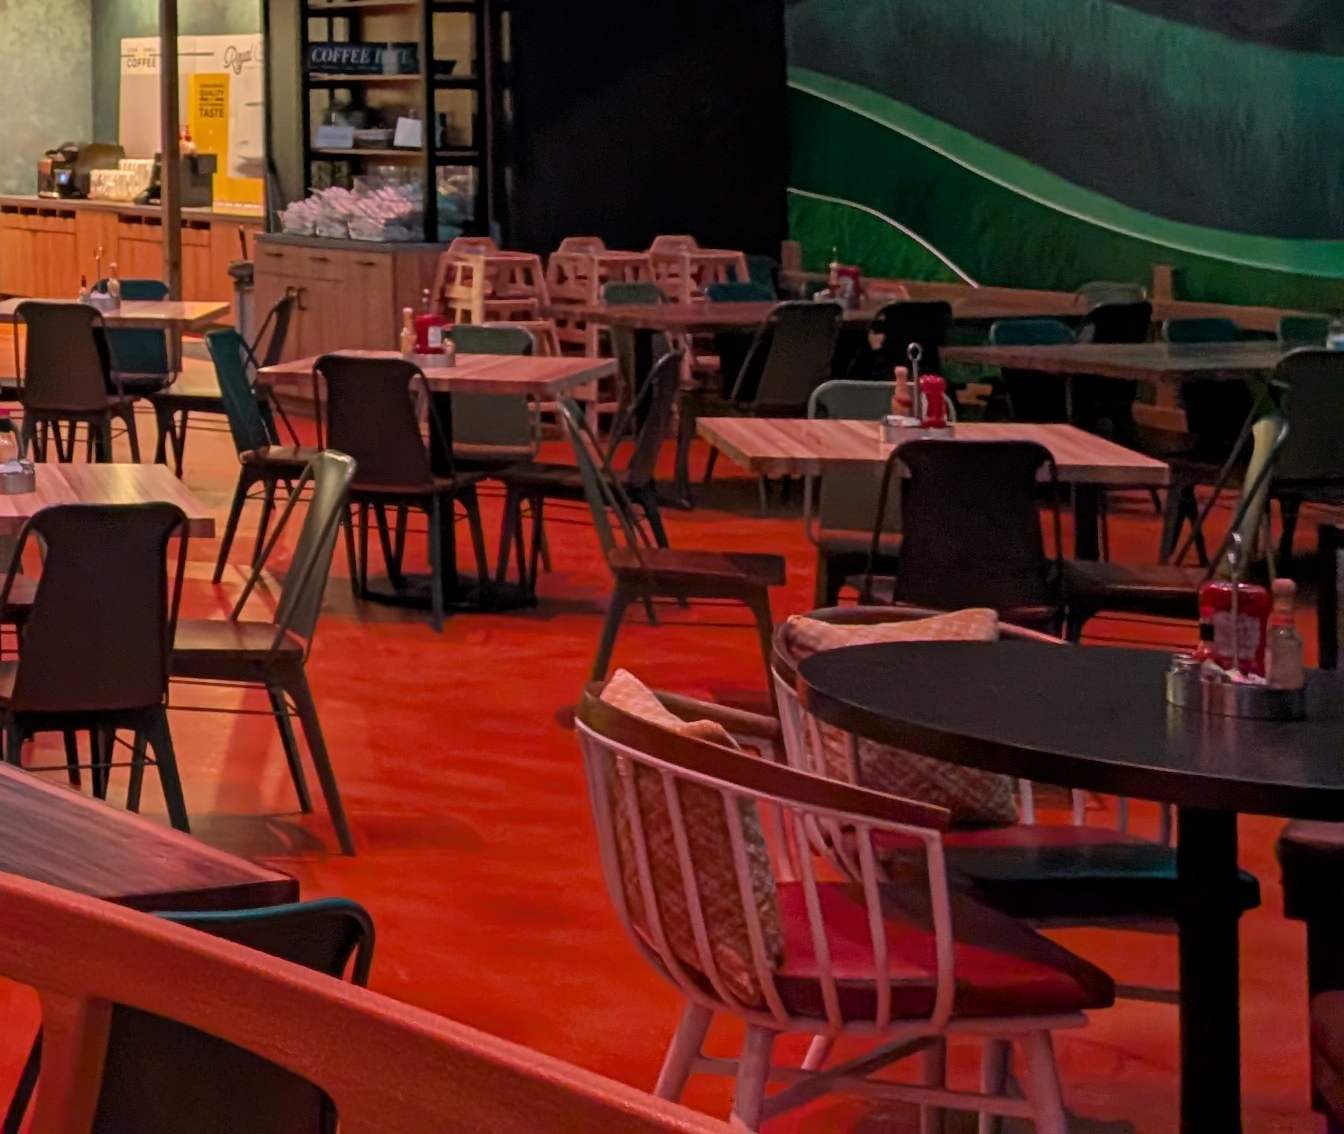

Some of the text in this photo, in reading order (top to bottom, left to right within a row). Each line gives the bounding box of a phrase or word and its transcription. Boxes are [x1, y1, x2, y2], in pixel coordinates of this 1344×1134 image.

[311, 46, 370, 64] COFFEE
[127, 57, 156, 68] COFFEE
[199, 89, 224, 98] QUALITY
[199, 107, 224, 118] TASTE
